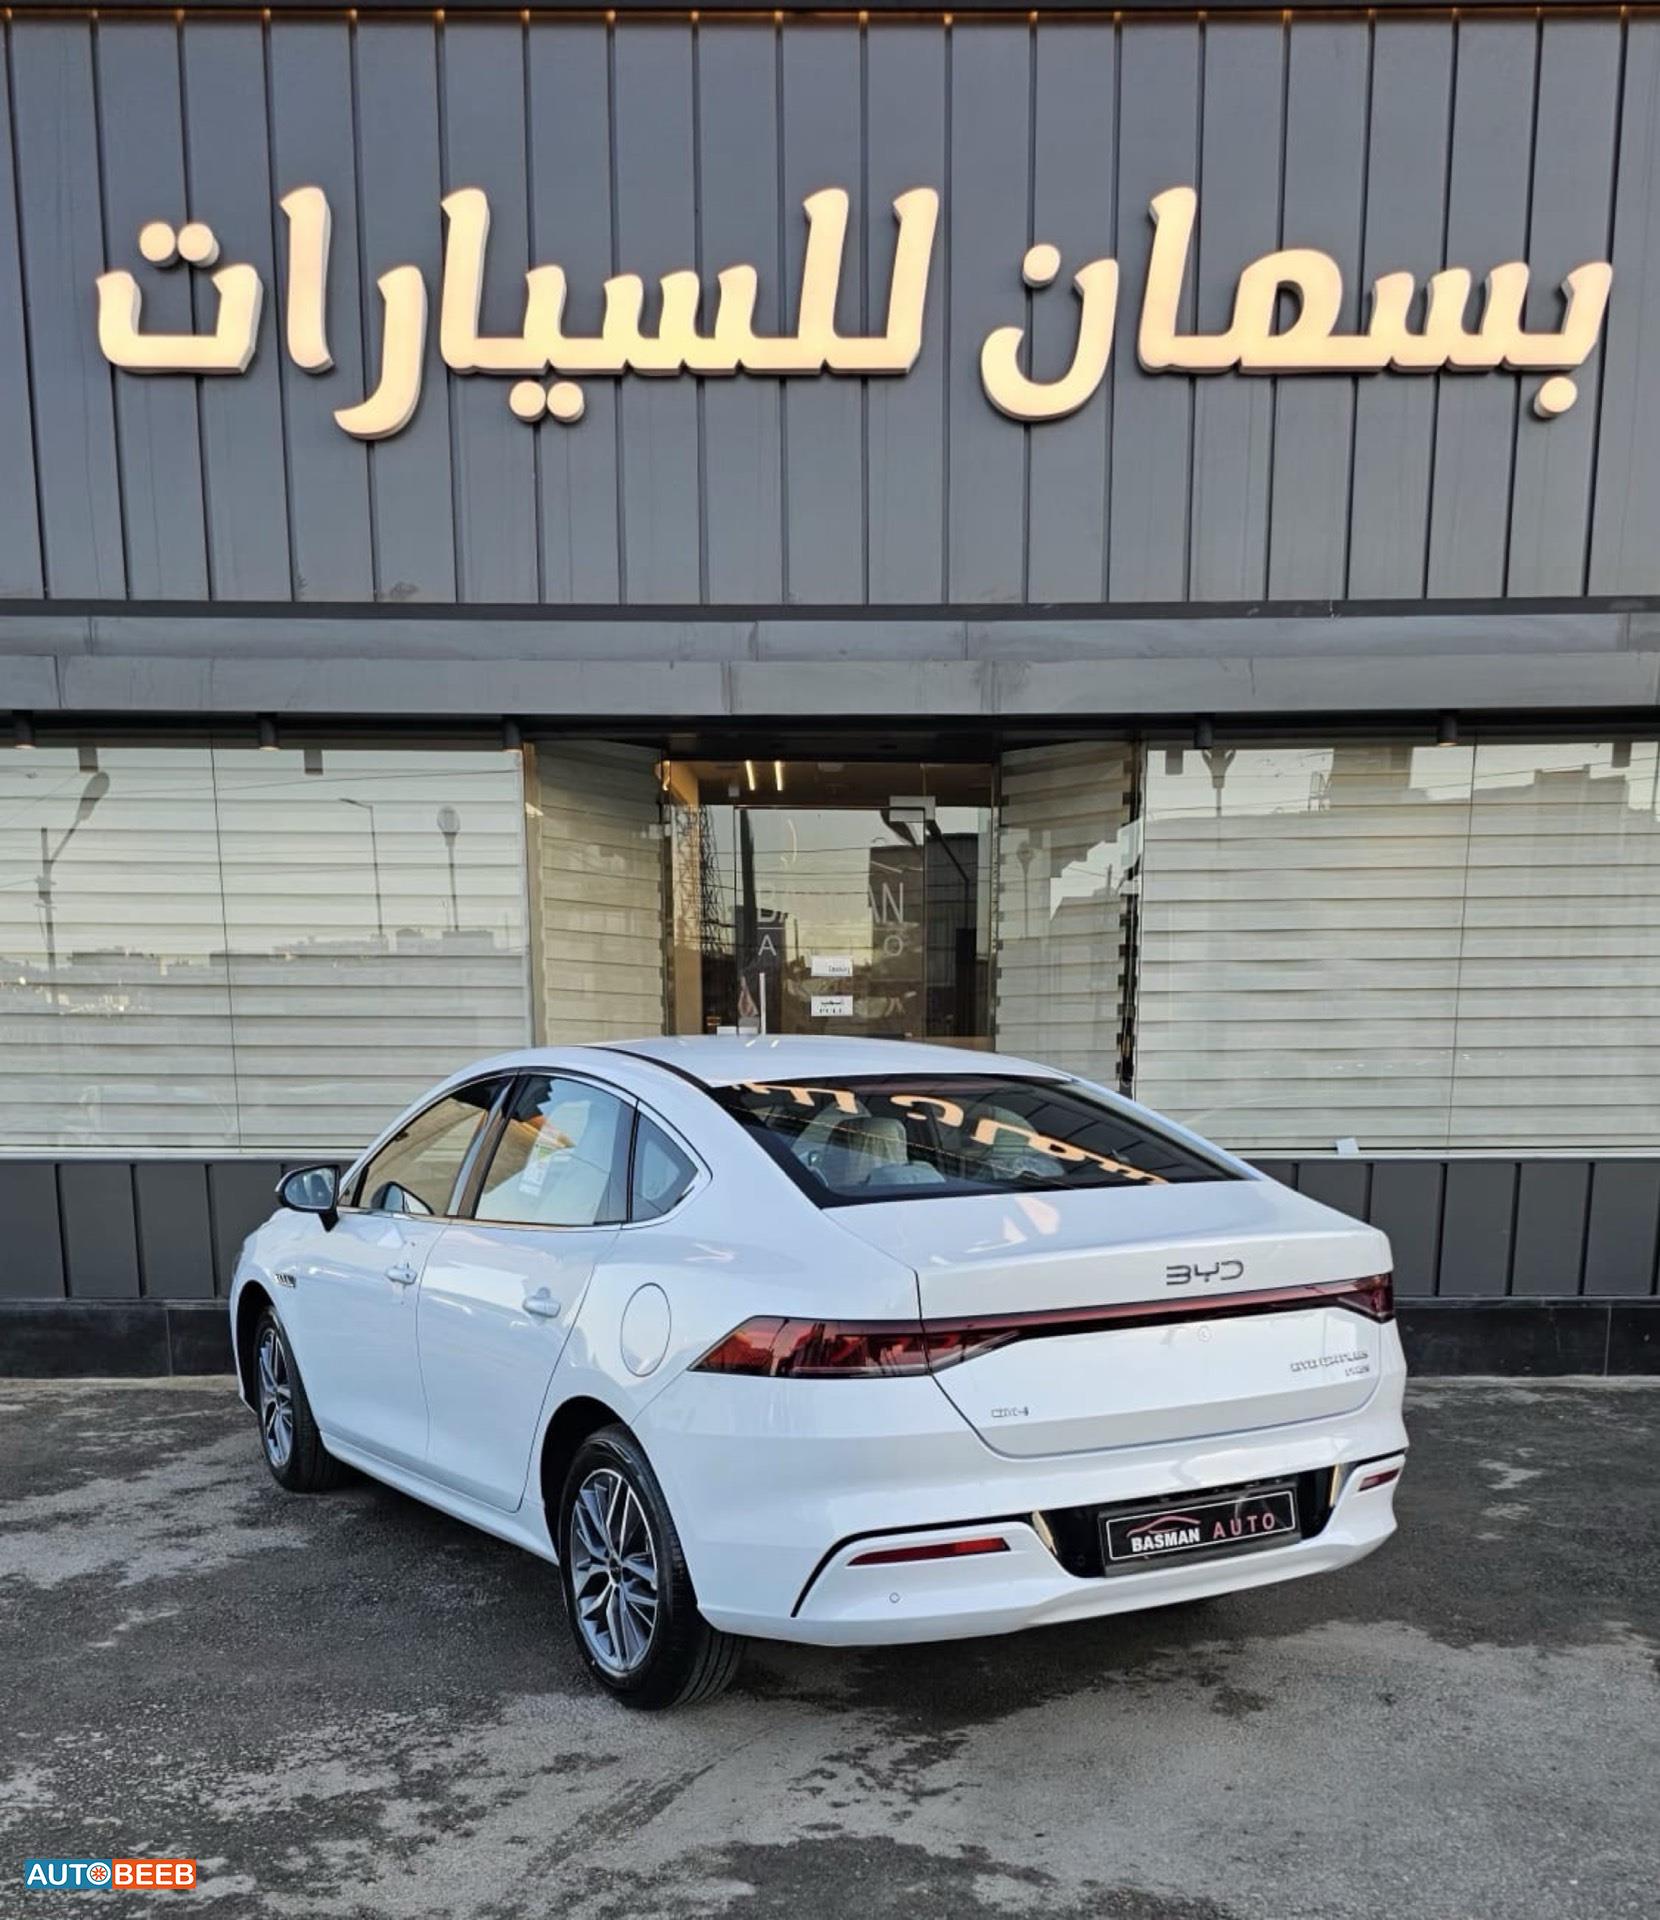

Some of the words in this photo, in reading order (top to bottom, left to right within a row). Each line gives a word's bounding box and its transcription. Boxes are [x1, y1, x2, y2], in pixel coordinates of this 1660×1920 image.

[95, 186, 940, 441] للسيارات
[979, 185, 1614, 422] بسمان
[1165, 1259, 1244, 1286] BYD
[1130, 1527, 1200, 1553] BASMAN
[1212, 1511, 1276, 1540] AUTO
